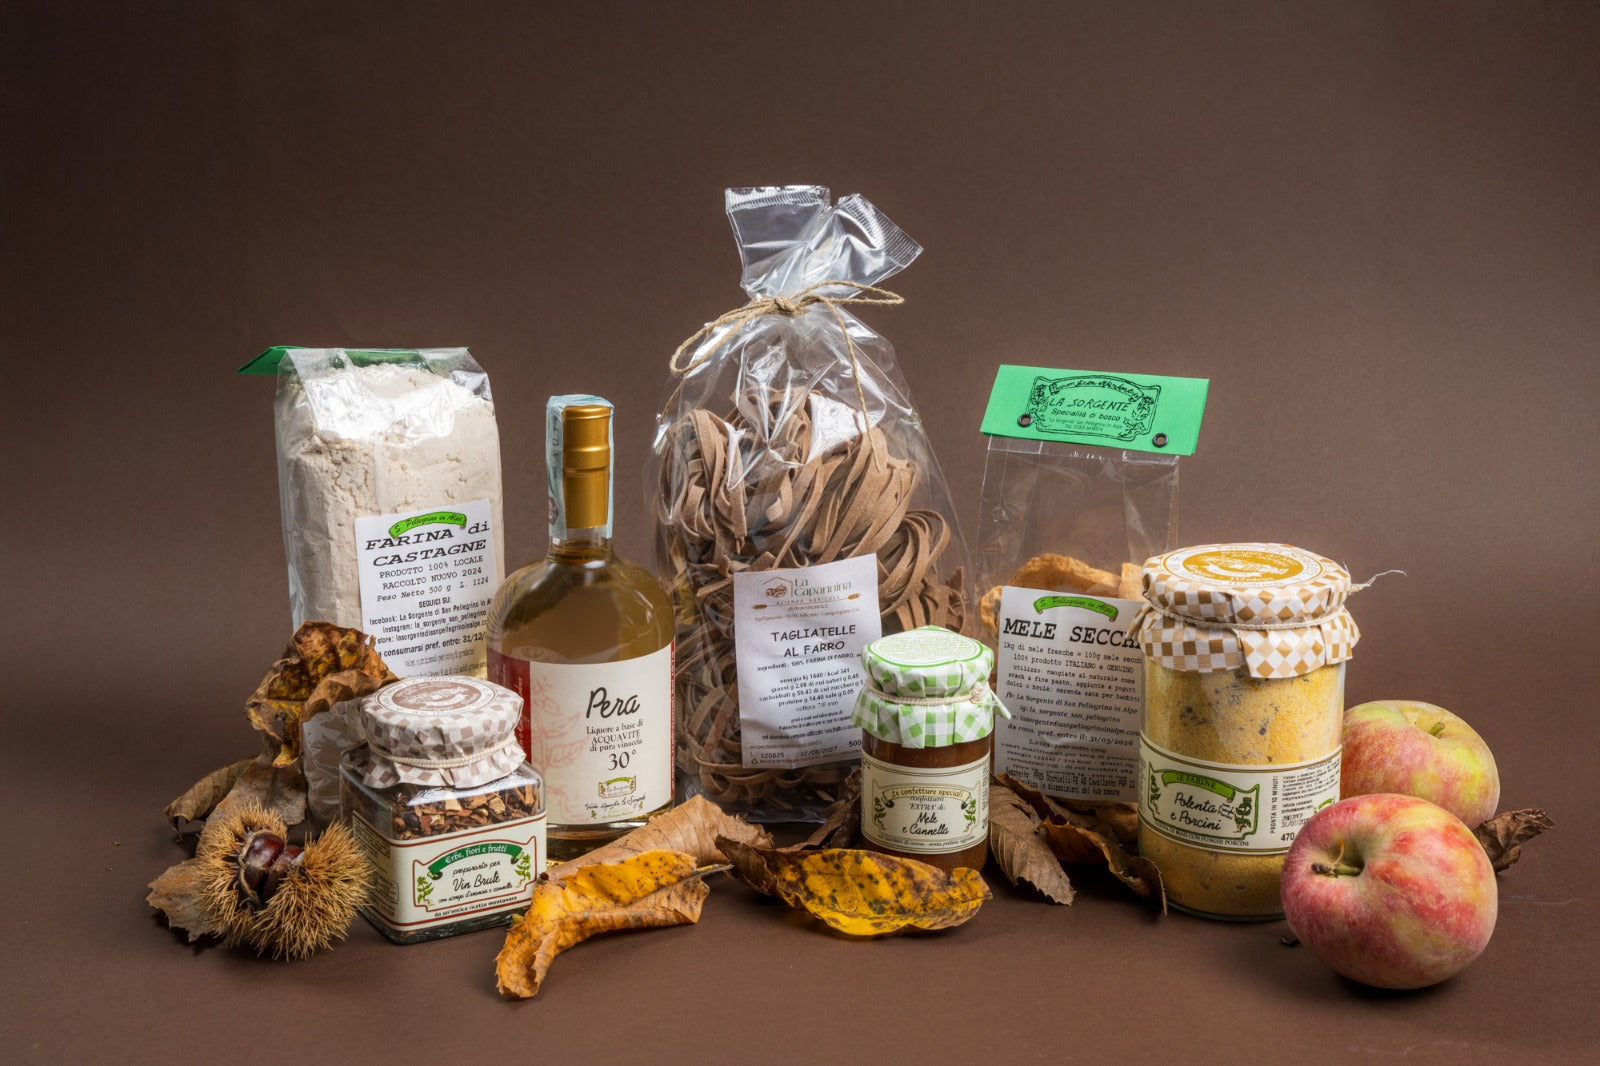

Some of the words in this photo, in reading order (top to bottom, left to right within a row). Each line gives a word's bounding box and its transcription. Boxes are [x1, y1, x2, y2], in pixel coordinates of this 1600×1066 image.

[1049, 398, 1064, 407] LA
[1067, 398, 1129, 412] SORGENTE
[365, 529, 454, 550] FARINA
[468, 521, 490, 535] di
[373, 539, 487, 567] CASTAGNE
[379, 566, 424, 579] PRODOTTO
[429, 561, 448, 571] 100%
[454, 555, 483, 567] LOCALE
[383, 577, 427, 590] RACCOLTO
[431, 572, 458, 583] NUOVO
[462, 566, 482, 577] 2024
[795, 578, 809, 587] La
[377, 594, 396, 602] Peso
[401, 589, 425, 599] Netto
[429, 585, 443, 594] 500
[408, 609, 433, 620] Sorgente
[441, 607, 452, 615] San
[453, 602, 480, 613] Pellegrino
[419, 598, 441, 609] SEGUICI
[771, 624, 857, 643] TAGLIATELLE
[1003, 618, 1057, 640] MELE
[384, 645, 424, 658] consumarsi
[425, 643, 441, 653] pref.
[442, 638, 461, 648] entro:
[784, 647, 799, 658] AL
[804, 641, 845, 656] FARRO
[1018, 643, 1025, 651] di
[1028, 645, 1044, 654] mele
[1047, 647, 1074, 657] fresche
[1031, 656, 1062, 667] prodotto
[1065, 660, 1097, 670] ITALIANO
[1107, 664, 1135, 674] GENUINO
[586, 687, 641, 719] Pera
[1026, 695, 1054, 706] Sorgente
[1064, 700, 1076, 708] San
[1078, 702, 1113, 713] Pellegrino
[1122, 707, 1138, 715] Alpe
[586, 726, 614, 736] Liquore
[621, 722, 635, 730] base
[637, 718, 644, 727] di
[1038, 730, 1055, 738] pref.
[590, 743, 597, 752] di
[599, 744, 615, 752] pura
[617, 739, 643, 749] vinaccia
[591, 730, 641, 745] ACQUAVITE
[901, 787, 937, 796] confetture
[1175, 792, 1217, 814] Polenta
[915, 812, 938, 825] Mele
[1171, 811, 1177, 820] e
[1179, 810, 1221, 831] Porcini
[902, 826, 907, 834] e
[909, 823, 949, 836] Cannella
[1281, 832, 1296, 841] 470
[466, 845, 481, 857] fiori
[488, 844, 508, 853] frutti
[489, 860, 500, 869] per
[453, 877, 471, 892] Vin
